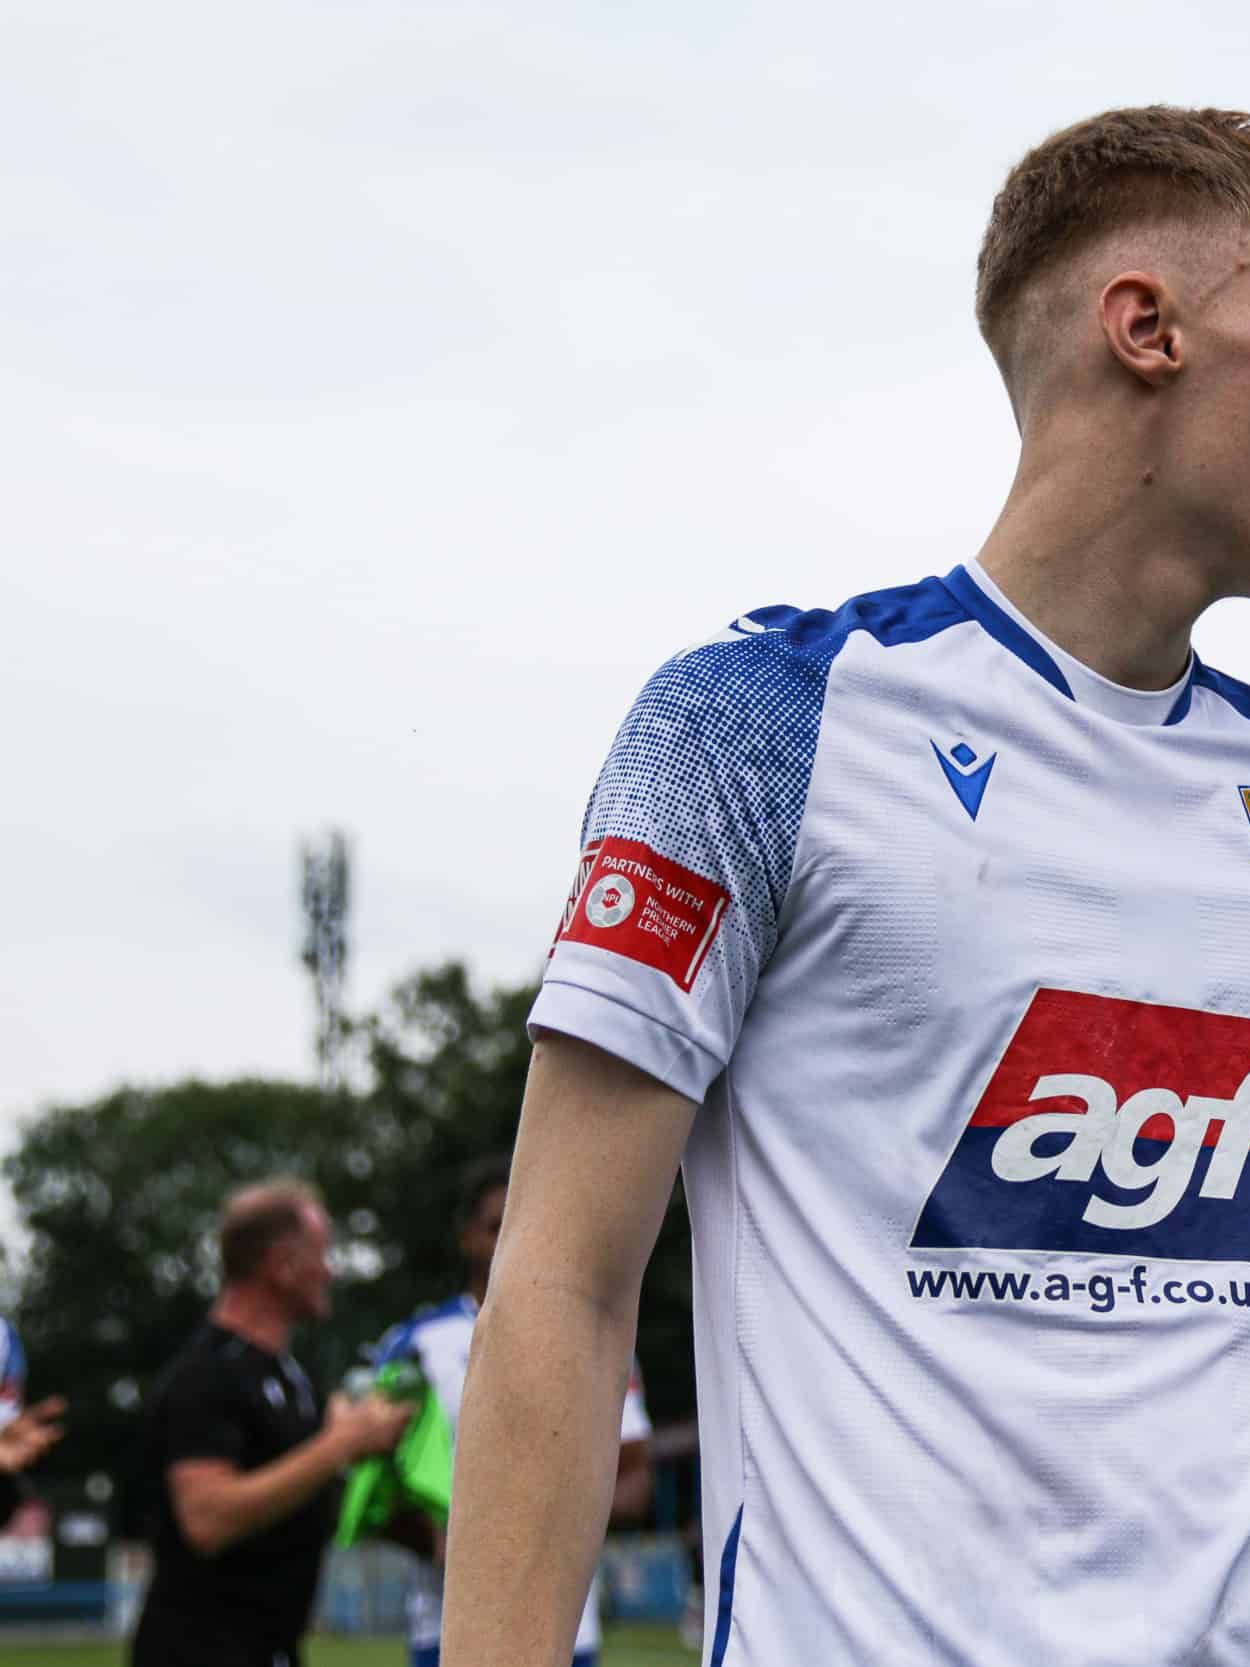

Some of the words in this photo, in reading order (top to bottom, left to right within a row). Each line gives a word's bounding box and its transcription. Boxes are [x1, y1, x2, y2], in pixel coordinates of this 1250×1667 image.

[601, 855, 663, 891] PARTNERS
[666, 883, 704, 912] WITH
[641, 907, 678, 940] PREIER
[646, 895, 697, 935] NOTHERN
